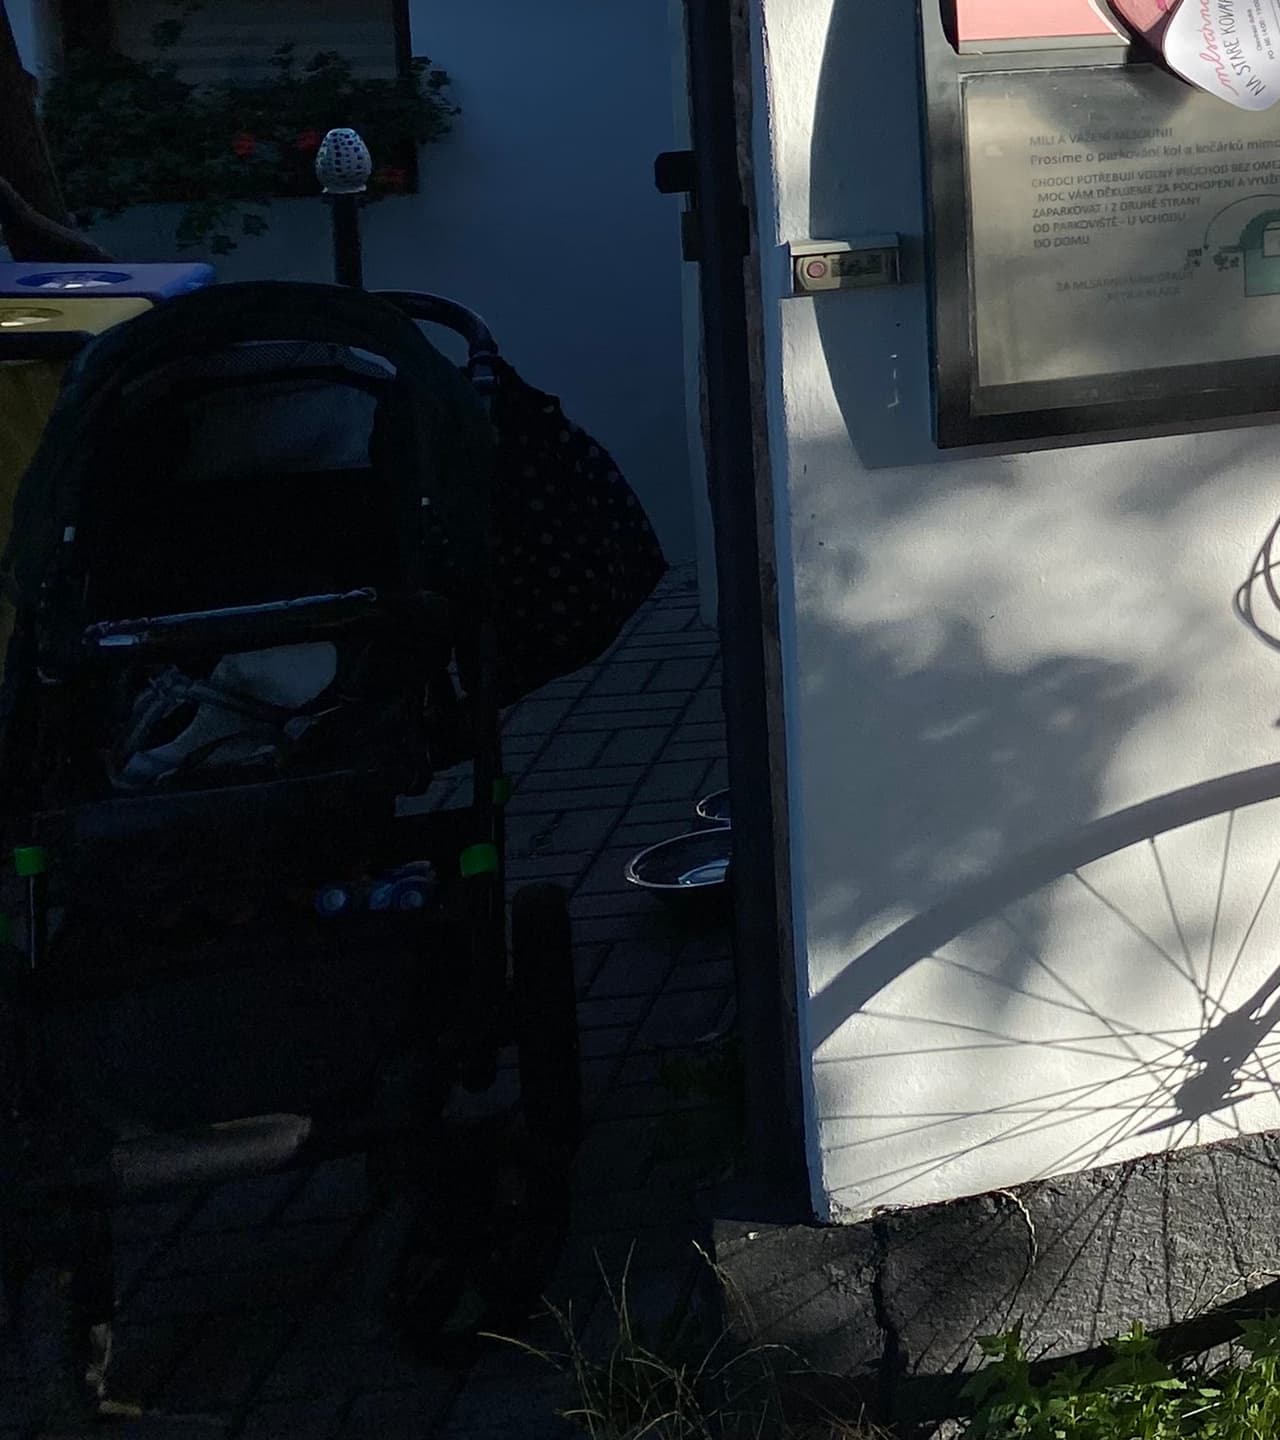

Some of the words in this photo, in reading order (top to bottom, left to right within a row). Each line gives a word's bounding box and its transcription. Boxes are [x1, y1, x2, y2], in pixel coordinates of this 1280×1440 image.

[1086, 154, 1094, 162] o
[1038, 191, 1065, 202] MOC
[1068, 187, 1093, 200] VÁM
[1160, 197, 1200, 208] STRANY
